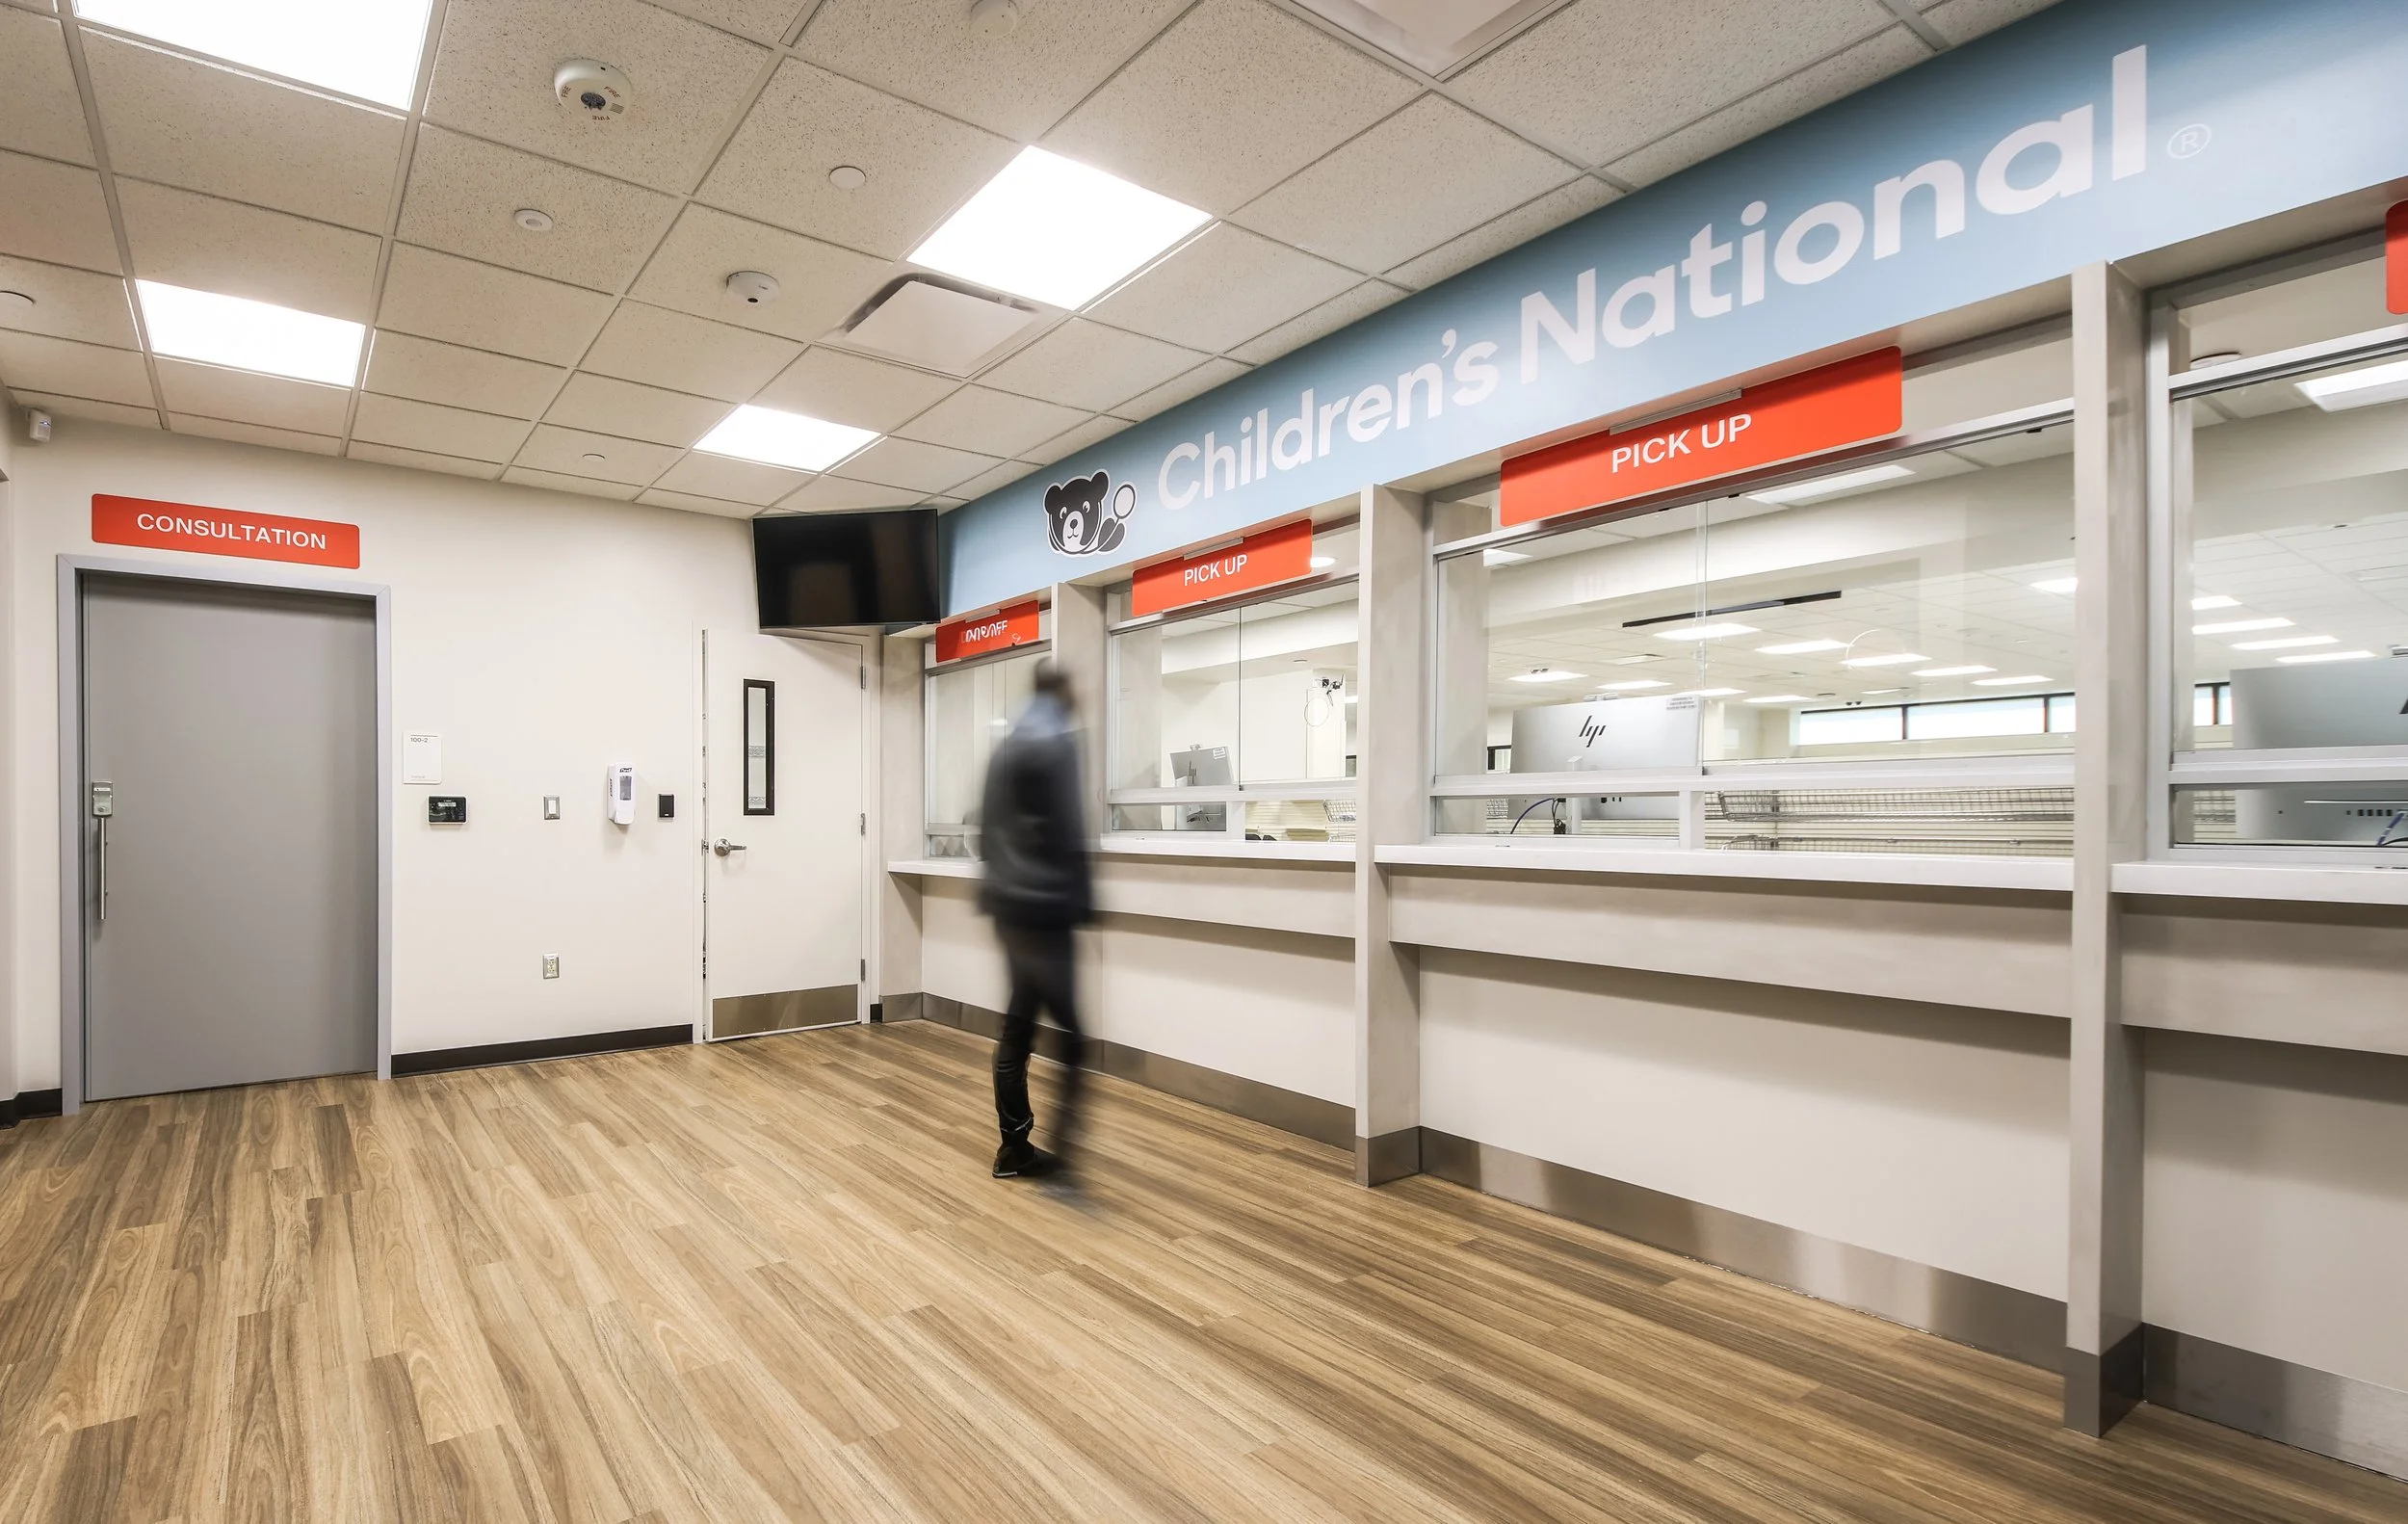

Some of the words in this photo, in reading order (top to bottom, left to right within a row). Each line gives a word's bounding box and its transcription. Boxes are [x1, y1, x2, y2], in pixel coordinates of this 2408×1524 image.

[604, 86, 621, 98] FIRE
[1158, 328, 1501, 511] Children's
[1520, 44, 2147, 386] National
[1611, 429, 1691, 474] PICK
[1701, 413, 1752, 449] UP
[136, 512, 327, 550] CONSULTATION
[1184, 560, 1221, 587] PICK
[1224, 554, 1248, 576] UP
